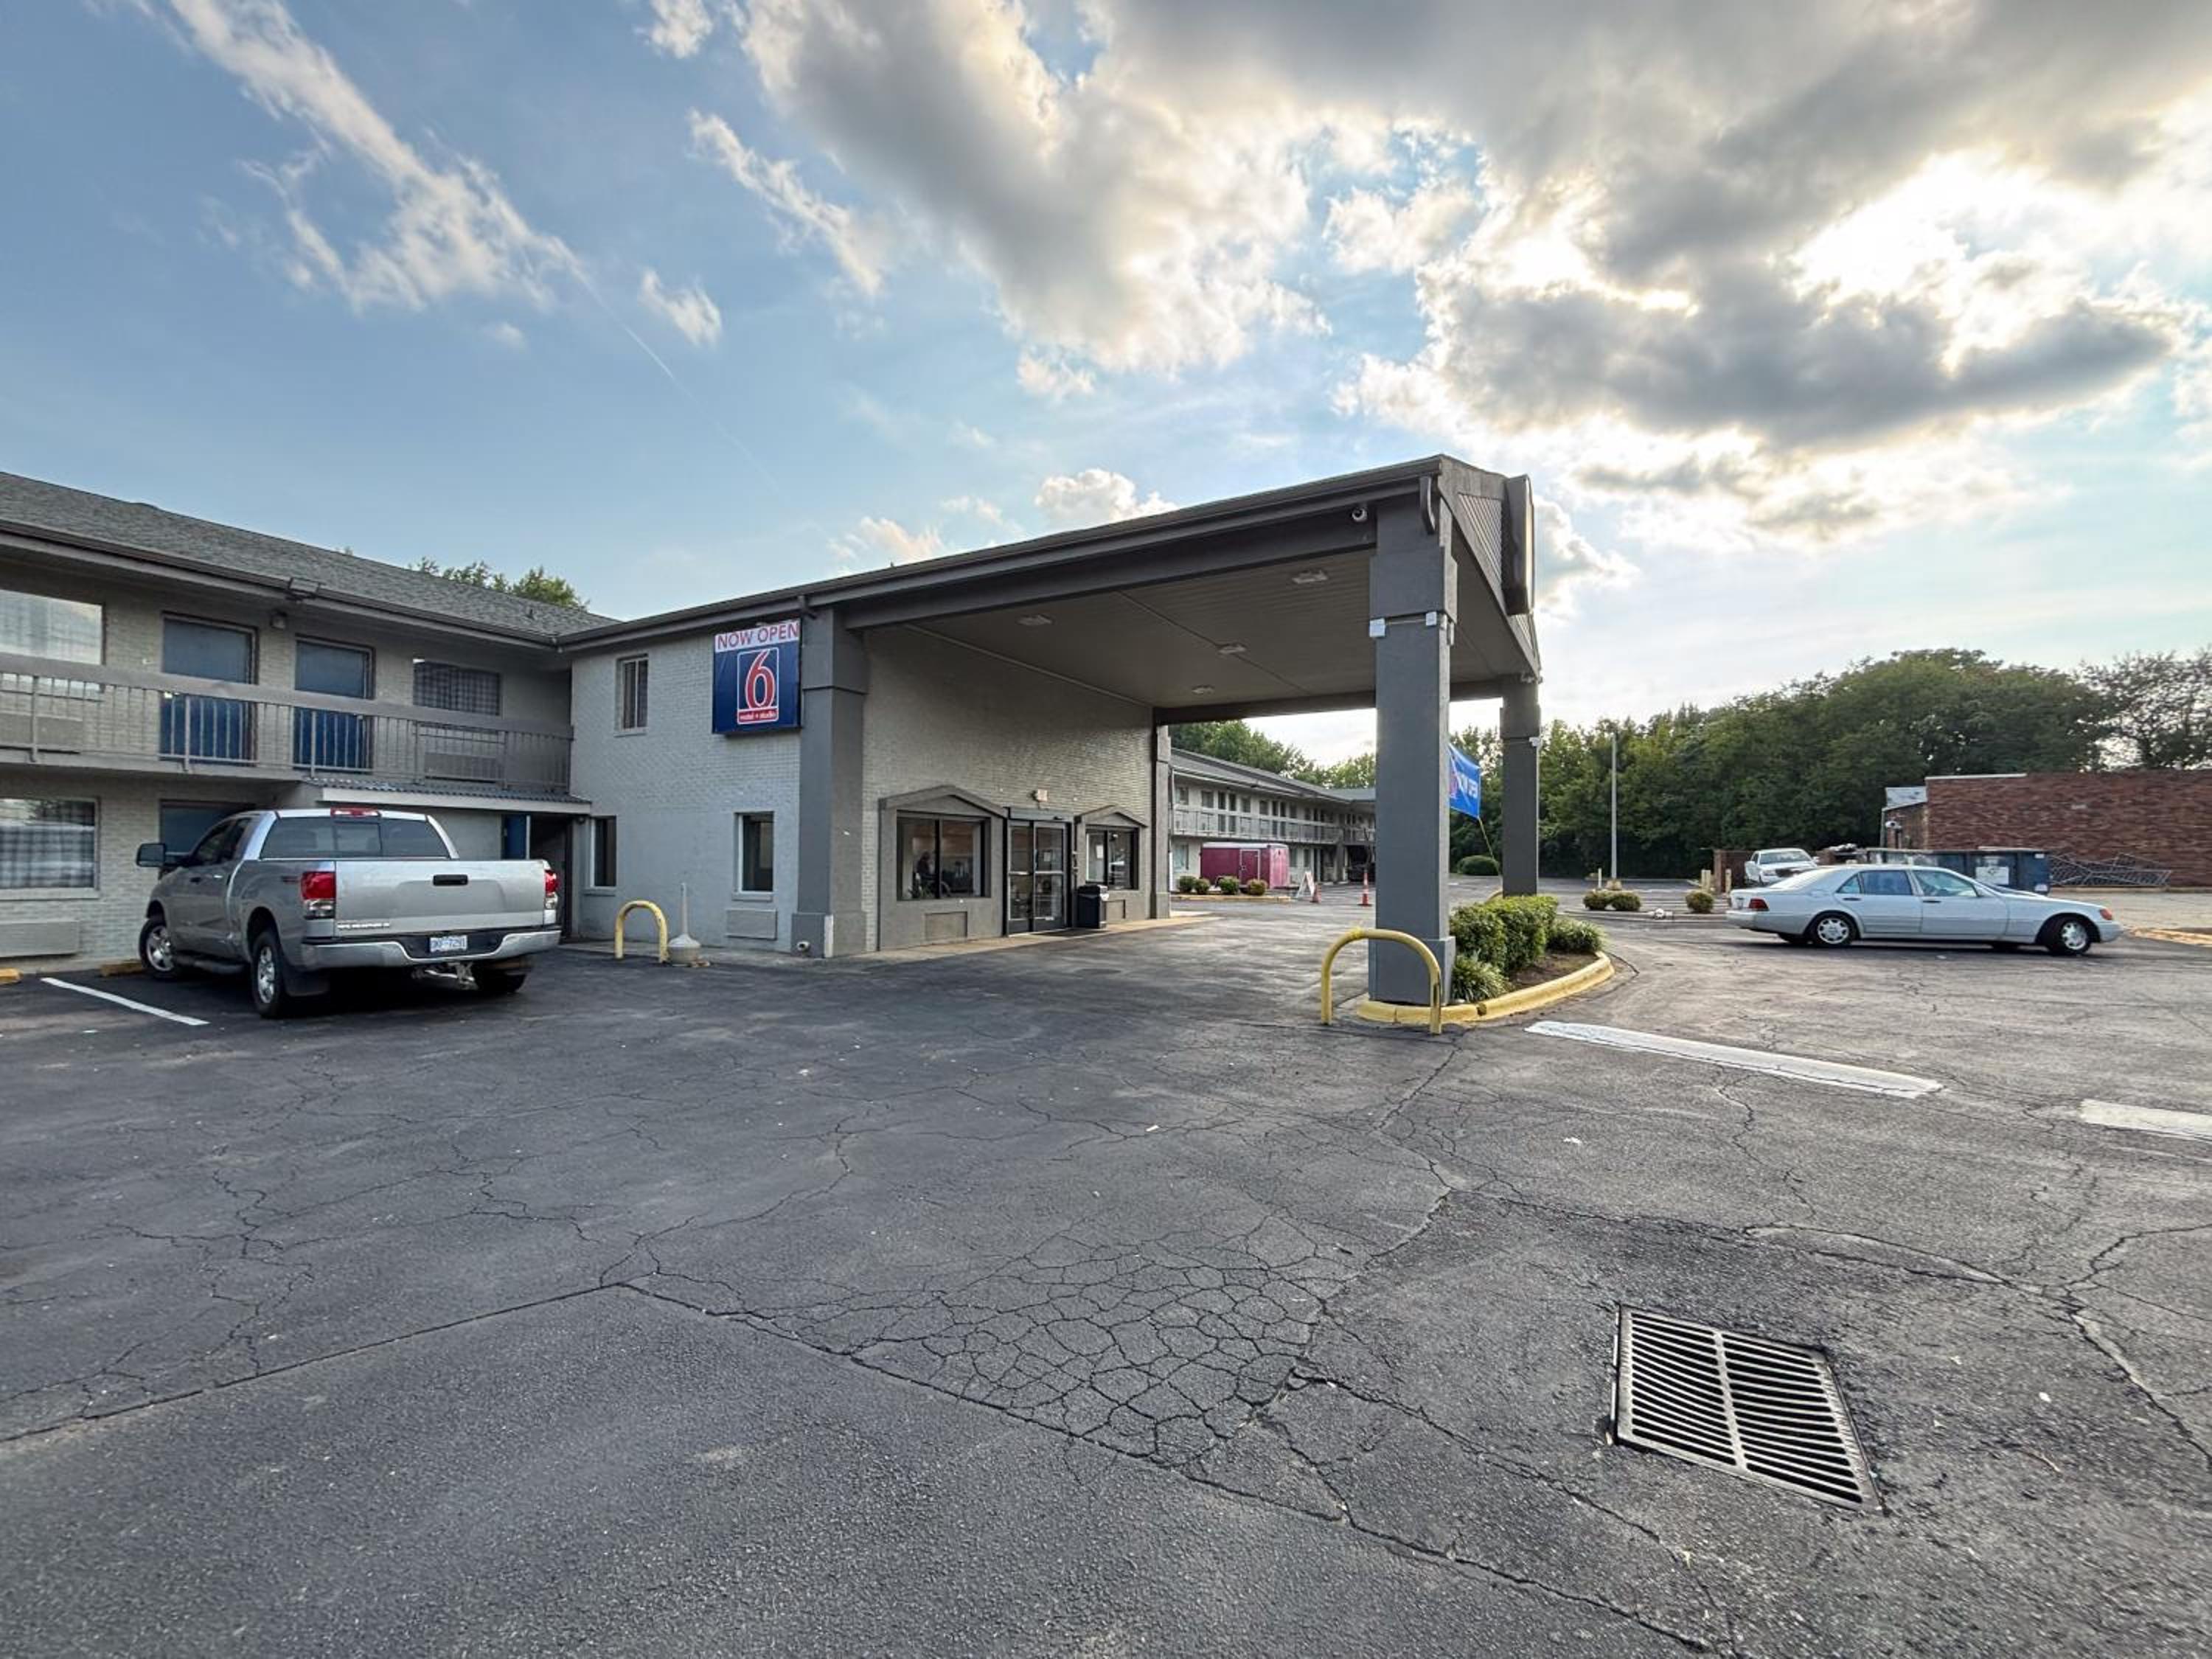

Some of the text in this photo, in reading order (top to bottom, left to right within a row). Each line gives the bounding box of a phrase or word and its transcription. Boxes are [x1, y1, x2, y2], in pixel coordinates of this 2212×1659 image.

[717, 623, 799, 650] NOW OPEN
[745, 648, 775, 709] 6
